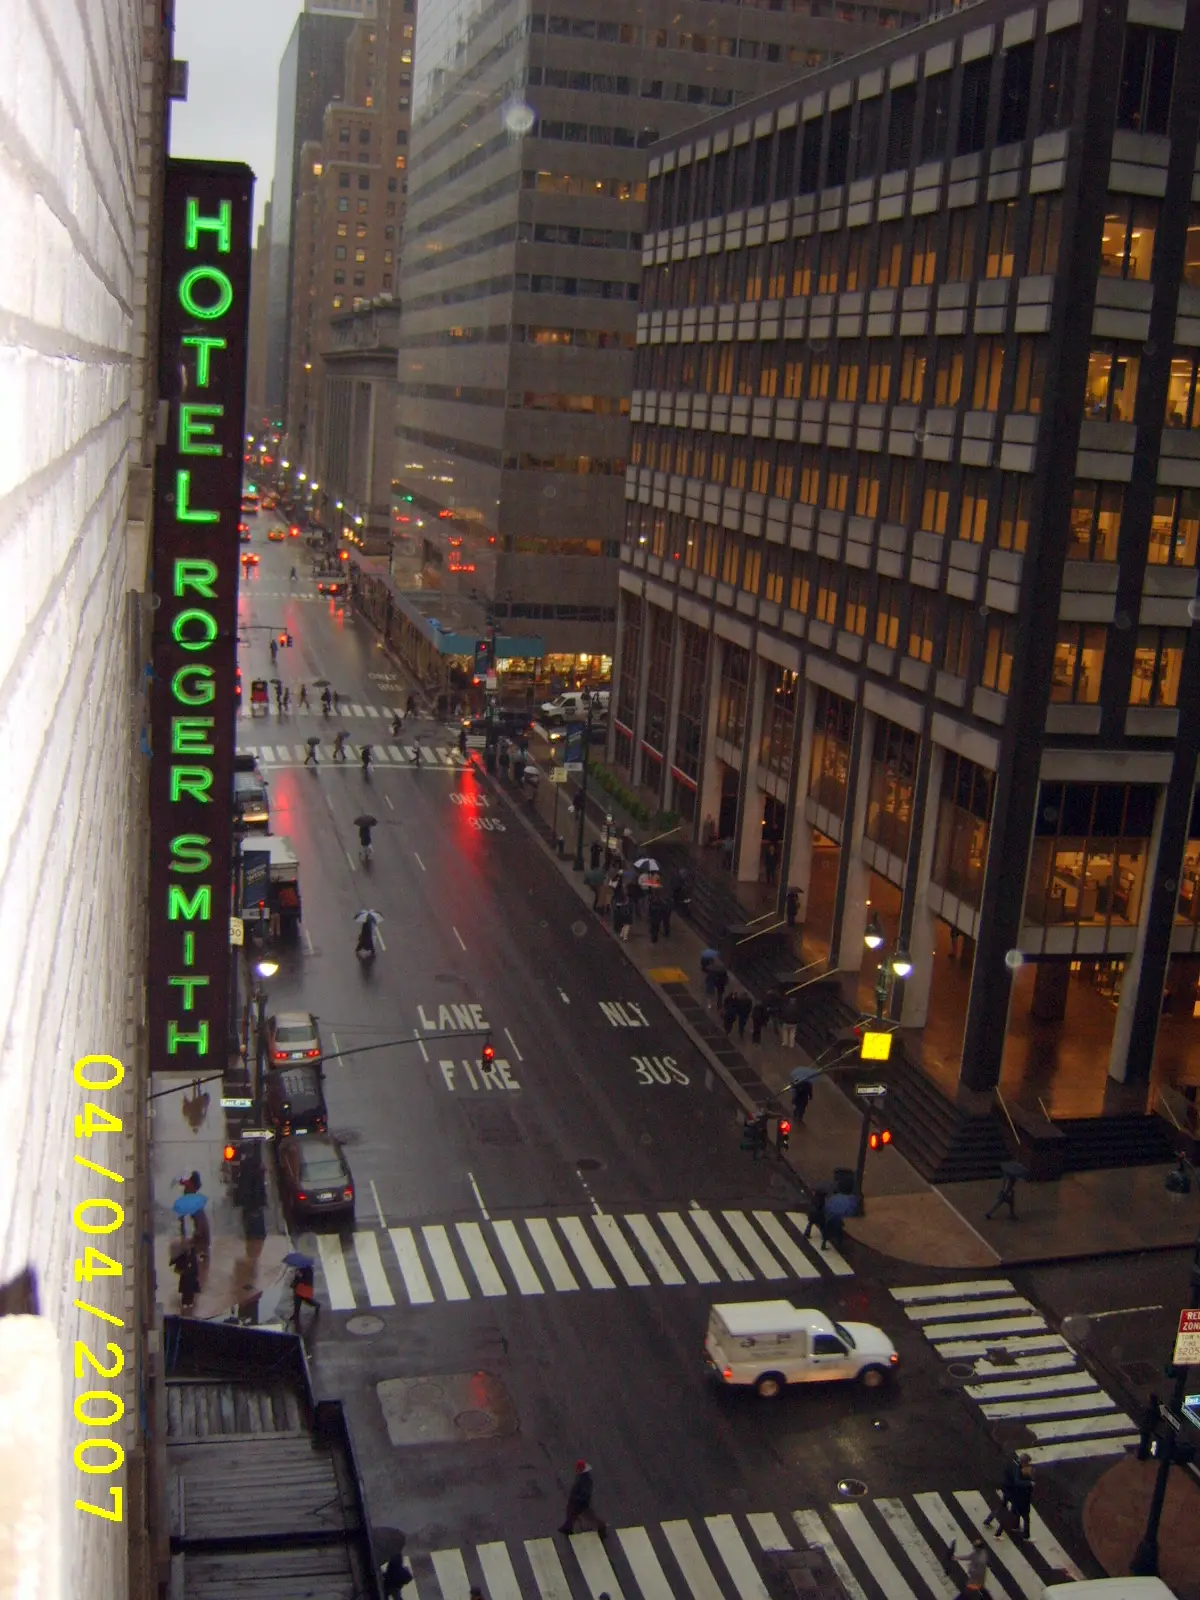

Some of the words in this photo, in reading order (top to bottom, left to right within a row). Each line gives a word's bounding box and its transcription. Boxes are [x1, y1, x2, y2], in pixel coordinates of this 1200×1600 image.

[174, 199, 234, 524] HOTEL
[170, 560, 219, 803] ROGER
[166, 834, 213, 1056] SMITH
[416, 1003, 491, 1031] LANE
[438, 1060, 521, 1091] FIRE
[1182, 1322, 1200, 1331] ZON
